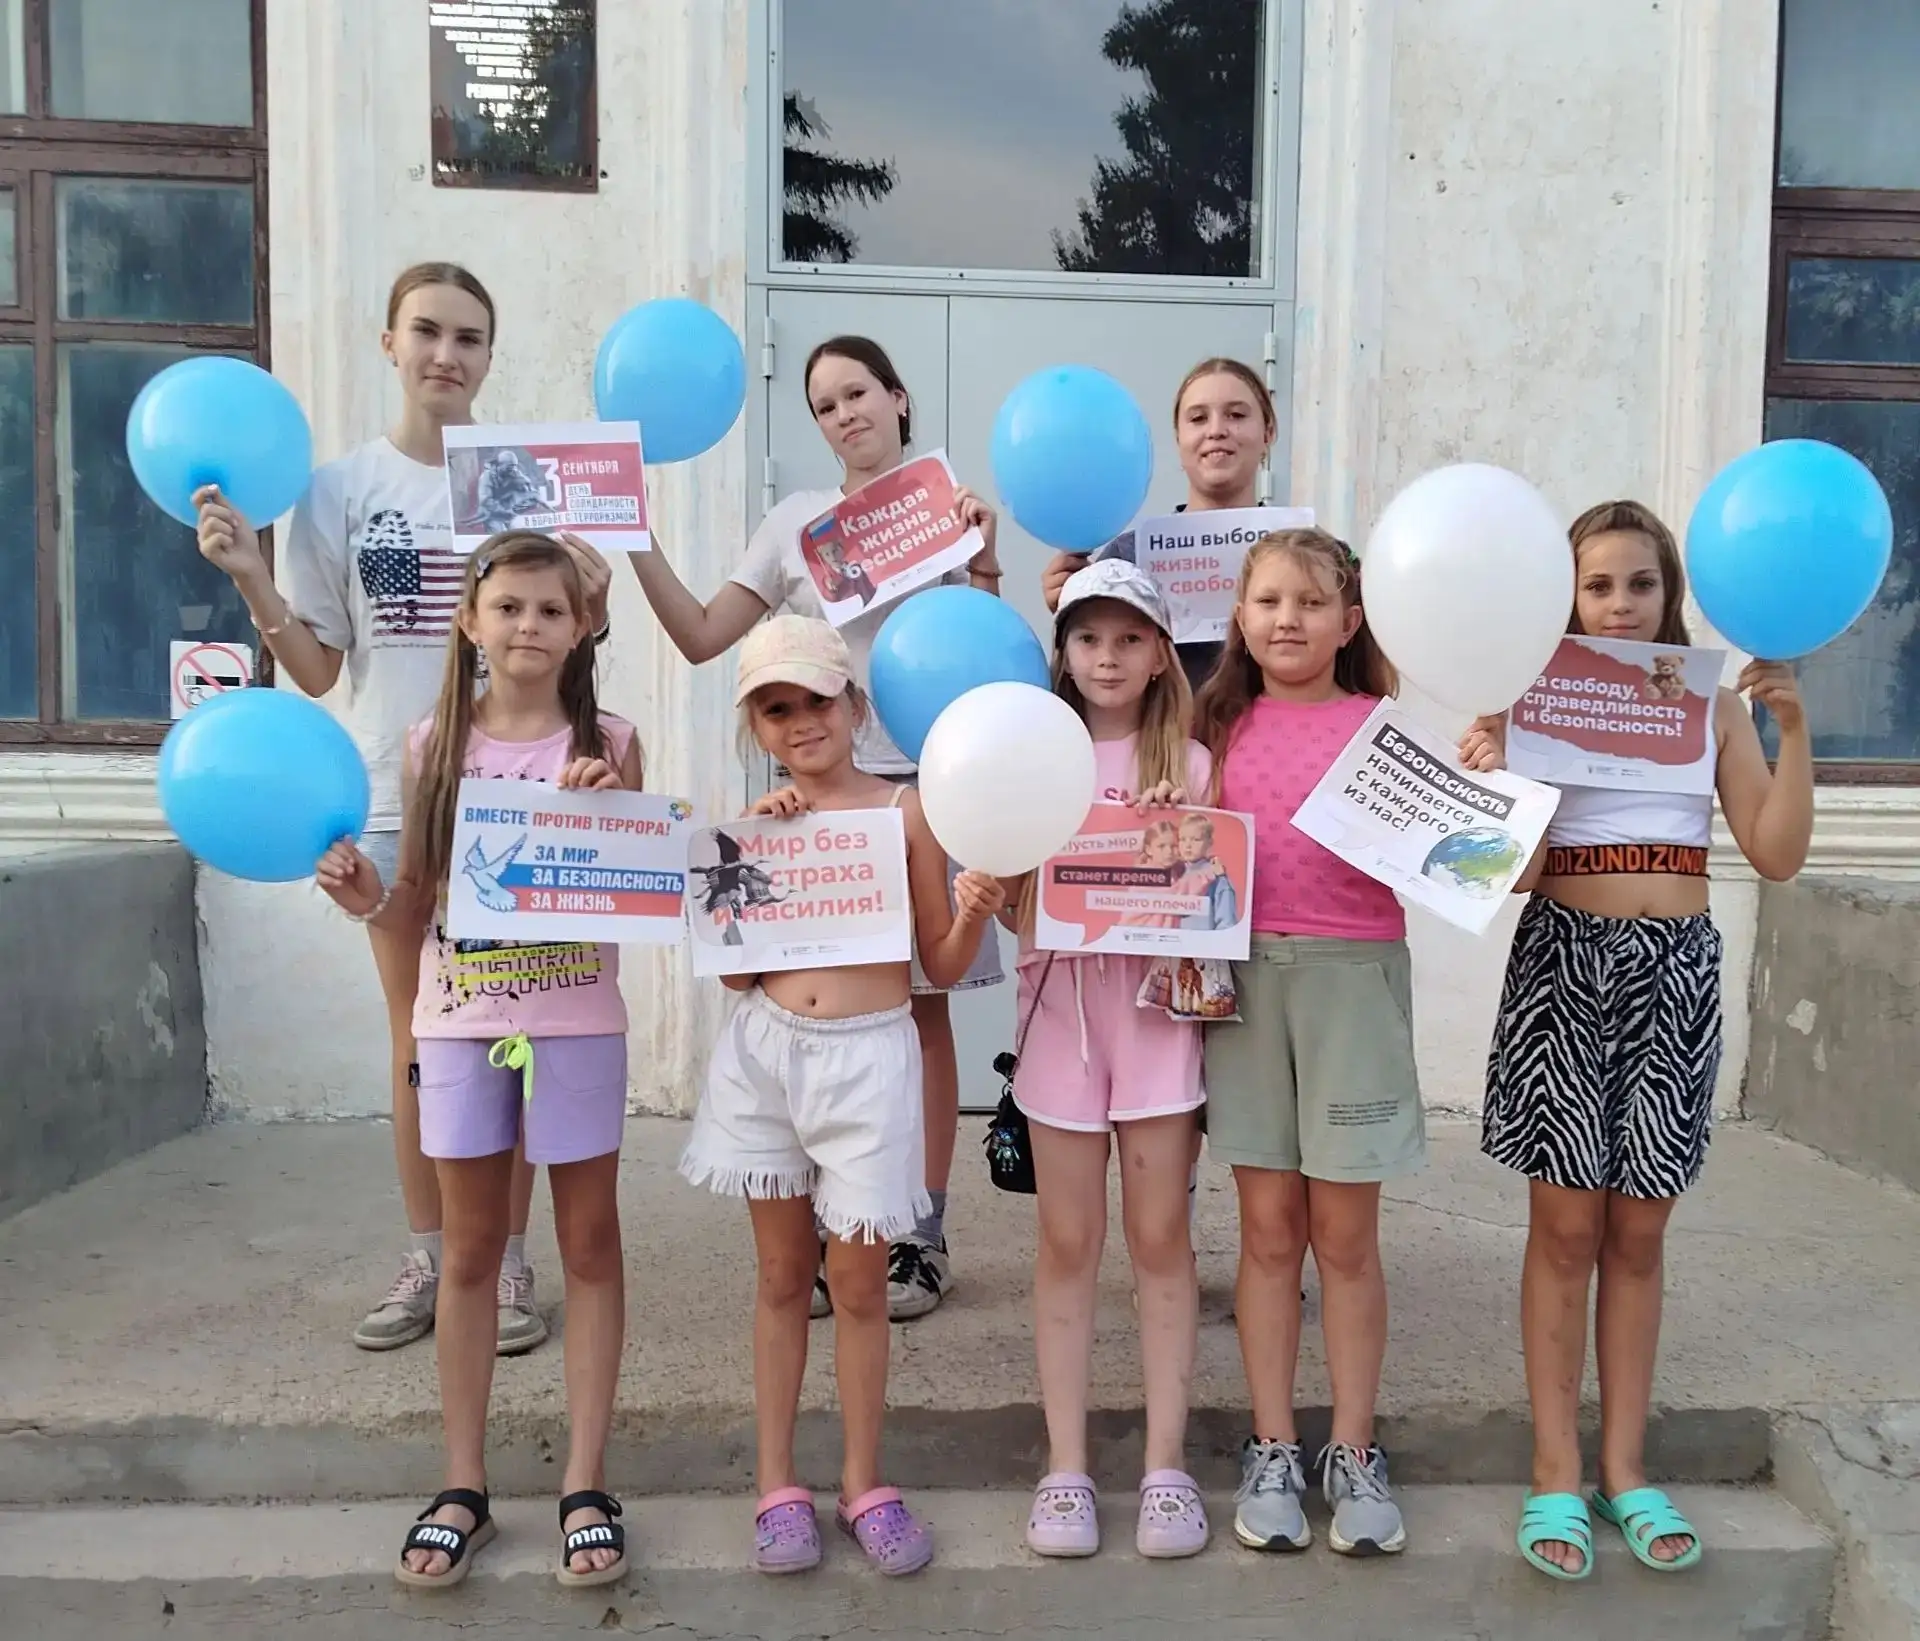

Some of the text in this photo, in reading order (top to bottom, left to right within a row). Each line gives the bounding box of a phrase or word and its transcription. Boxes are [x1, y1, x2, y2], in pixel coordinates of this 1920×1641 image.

[536, 457, 619, 507] 3 СЕНТЯБРЯ
[840, 487, 929, 537] Каждая
[843, 508, 961, 579] бесценна!
[859, 508, 932, 553] жизнь
[1150, 534, 1194, 551] Наш
[1150, 556, 1220, 573] жизнь
[1170, 575, 1235, 594] свобо
[1535, 674, 1640, 701] а свободу,
[1523, 692, 1687, 721] справедливость
[1523, 707, 1683, 737] и безопасность!
[1379, 729, 1508, 816] Безопасность
[1355, 769, 1450, 834] с каждого
[1366, 753, 1476, 826] начинается
[464, 807, 671, 836] ВМЕСТЕ ПРОТИВ ТЕРРОРА!
[1344, 784, 1412, 833] из нас!
[535, 845, 599, 864] ЗА МИР
[736, 827, 868, 860] Мир без
[1108, 837, 1138, 849] мир
[532, 868, 683, 892] ЗА БЕЗОПАСНОСТЬ
[770, 862, 874, 891] страха
[1060, 870, 1166, 885] станет крепче
[530, 892, 616, 911] ЗА ЖИЗНЬ
[713, 890, 884, 926] и насилия!
[1095, 896, 1201, 911] нашего плеча!
